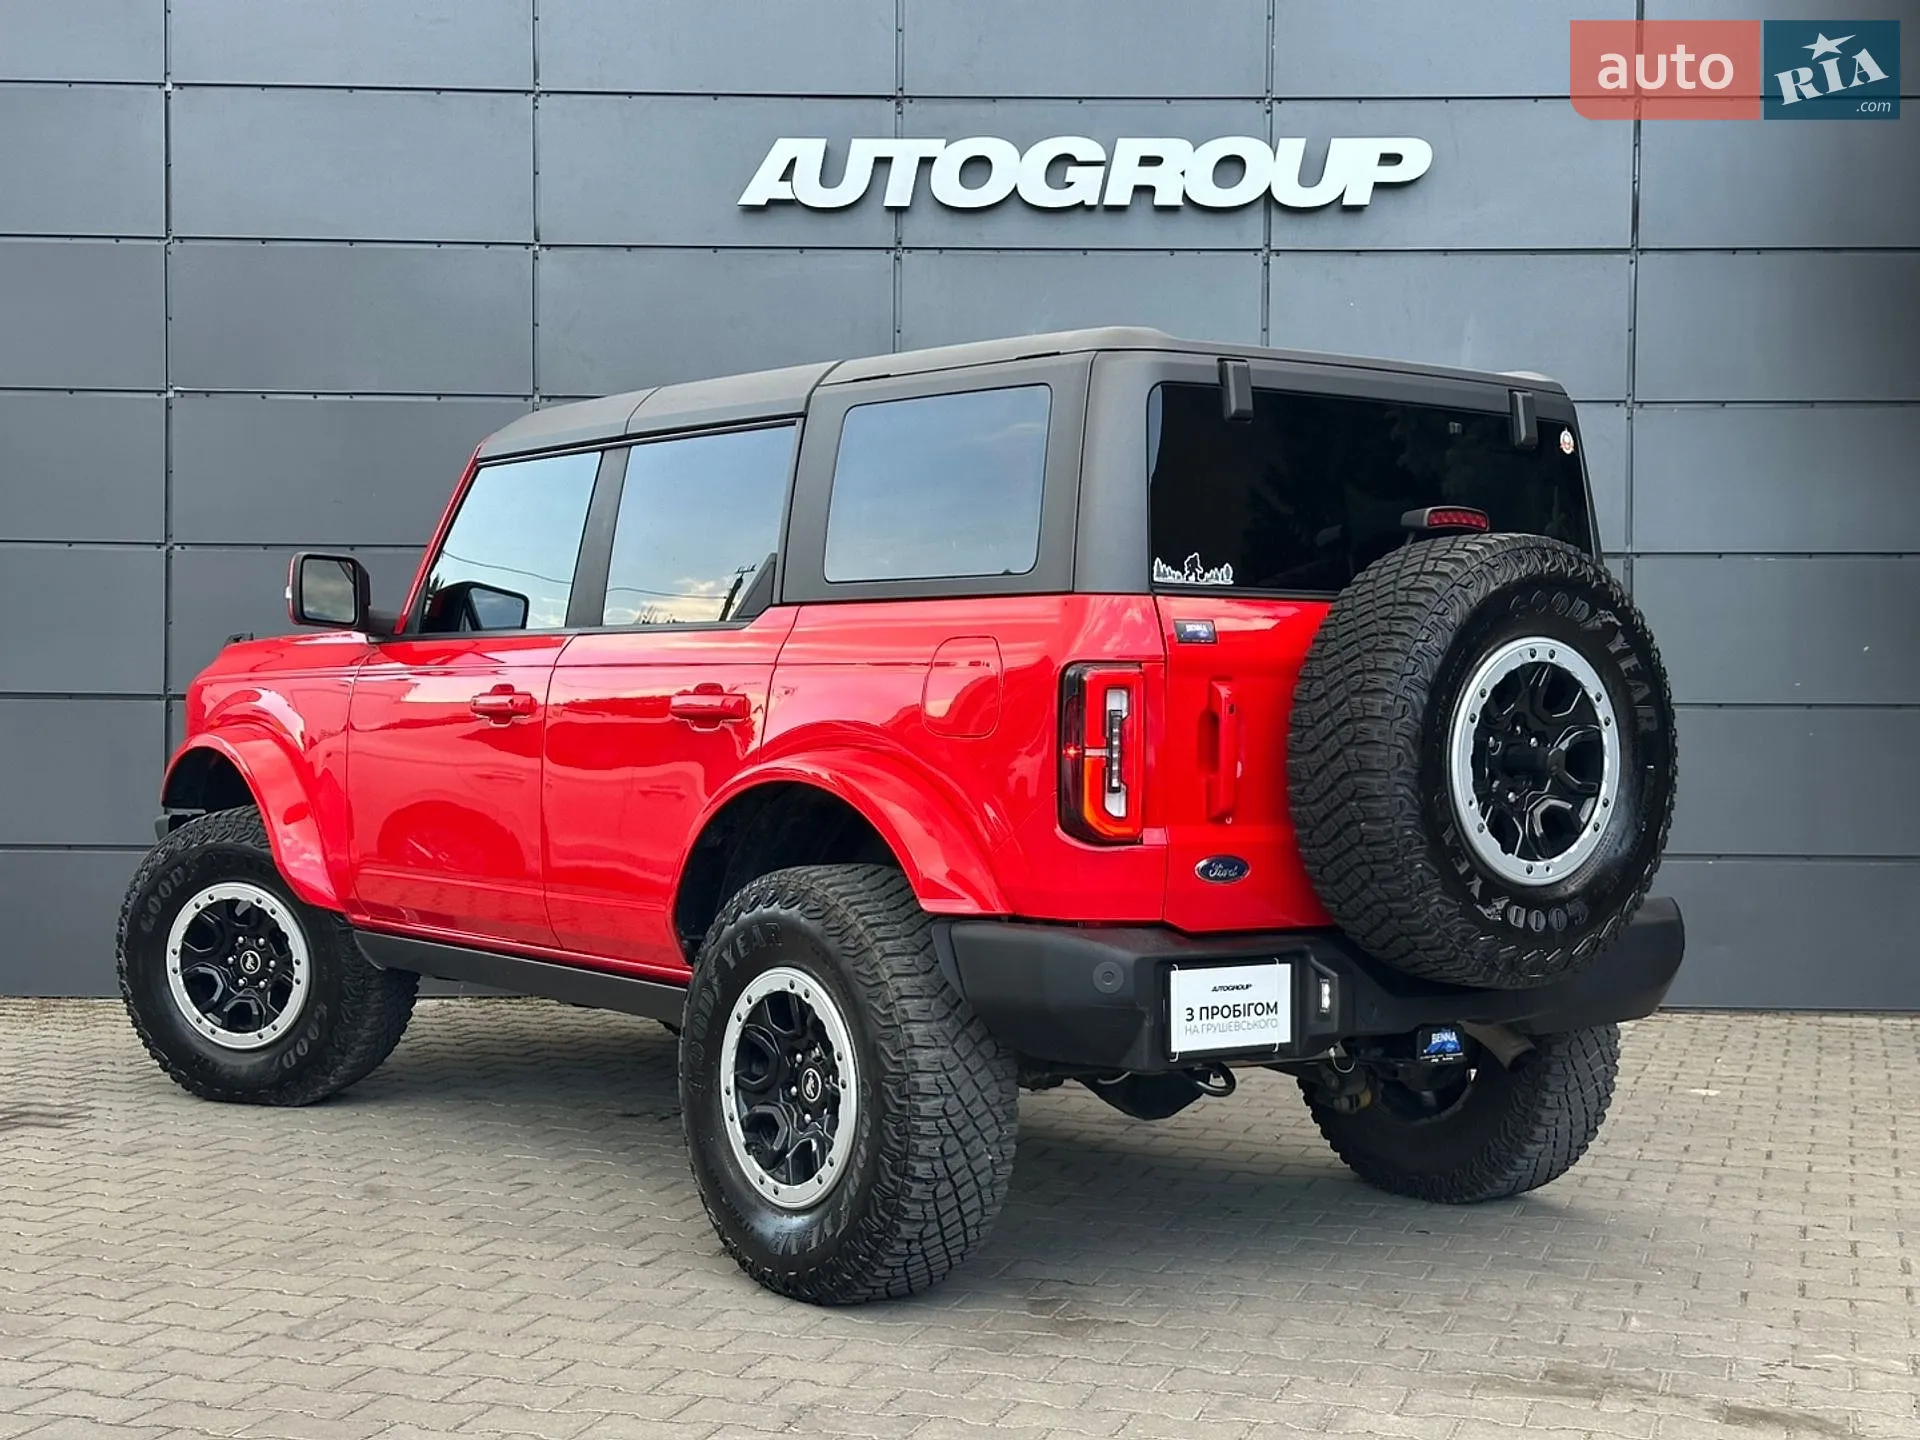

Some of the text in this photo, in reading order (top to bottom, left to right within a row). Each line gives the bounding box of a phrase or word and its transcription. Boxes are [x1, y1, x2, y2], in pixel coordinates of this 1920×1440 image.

[737, 135, 1433, 210] AUTOGROUP
[1208, 862, 1239, 878] Ford
[1211, 983, 1252, 992] AUTOGROUP
[1199, 1001, 1278, 1021] ПРОБІГОМ
[1185, 1018, 1278, 1036] НА ГРУШЕВСЬКОГО
